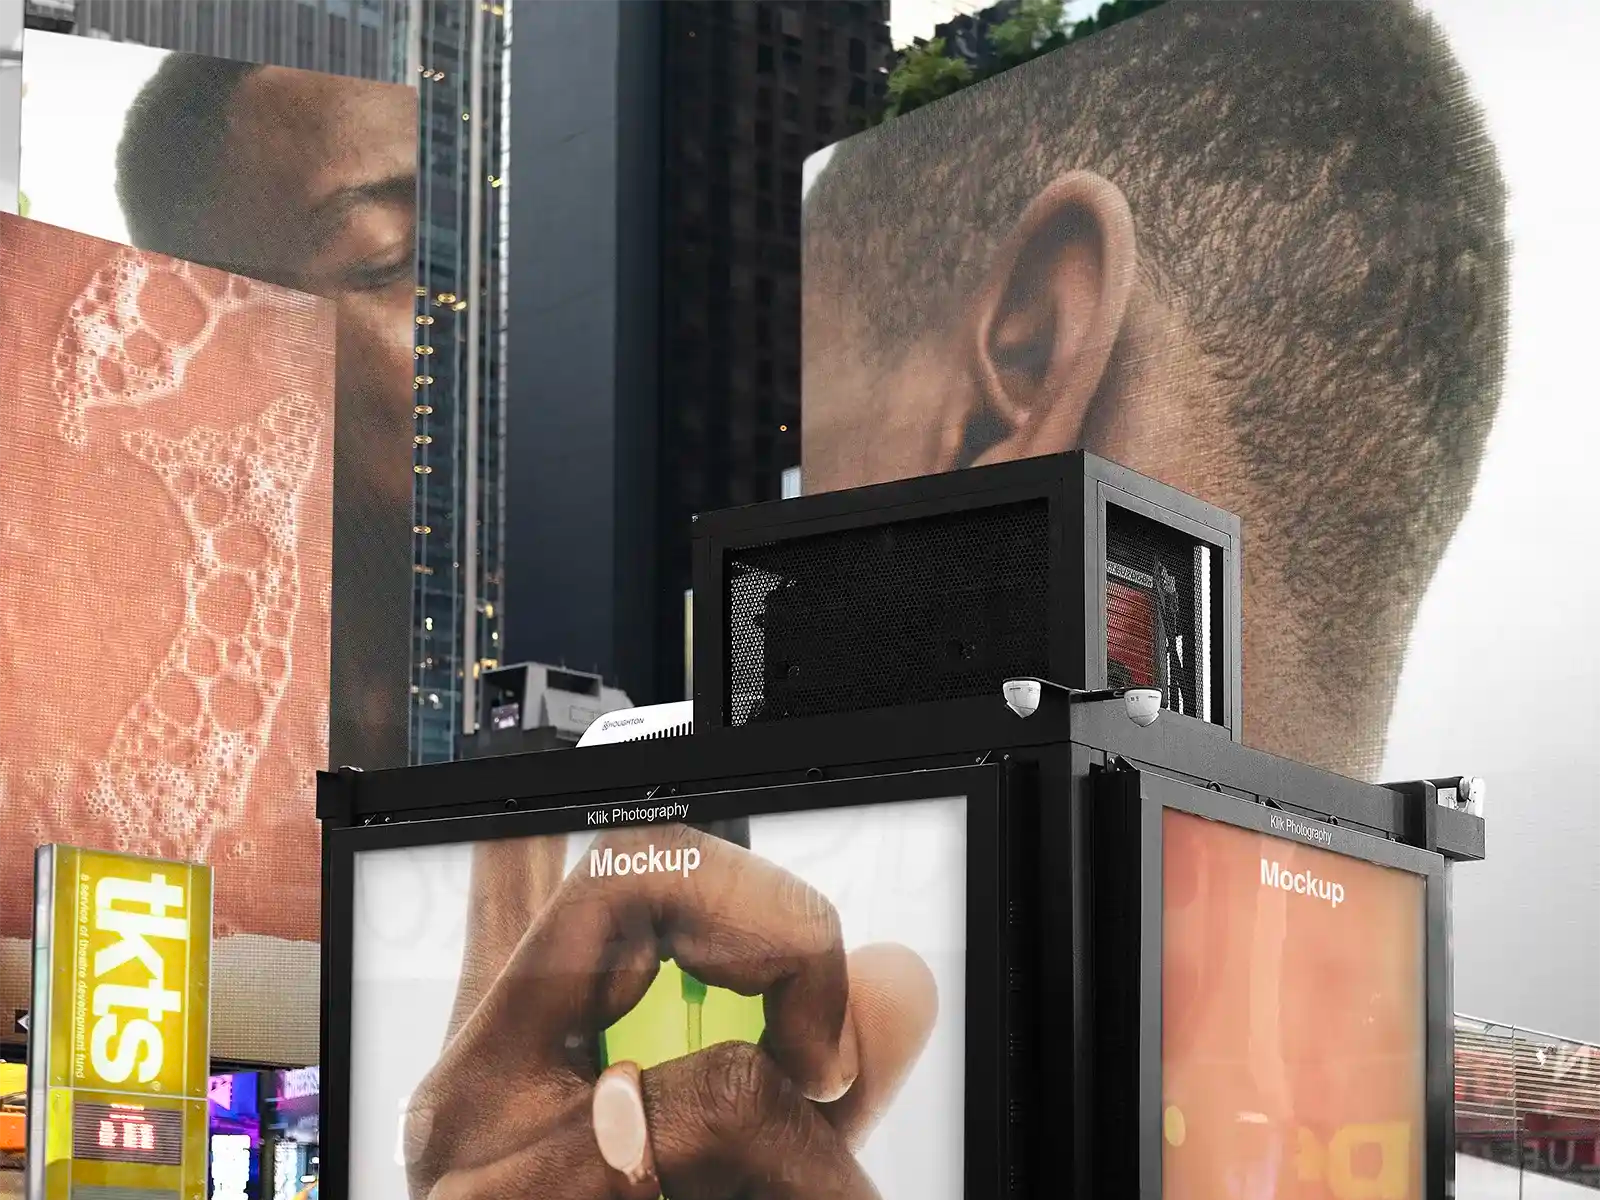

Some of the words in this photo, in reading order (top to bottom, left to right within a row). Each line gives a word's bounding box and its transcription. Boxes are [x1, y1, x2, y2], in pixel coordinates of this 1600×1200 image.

[587, 811, 609, 825] Klik
[612, 802, 689, 822] Photography
[1270, 814, 1285, 831] Klik
[1286, 818, 1332, 845] Photography
[590, 844, 700, 878] Mockup
[1260, 858, 1345, 908] Mockup
